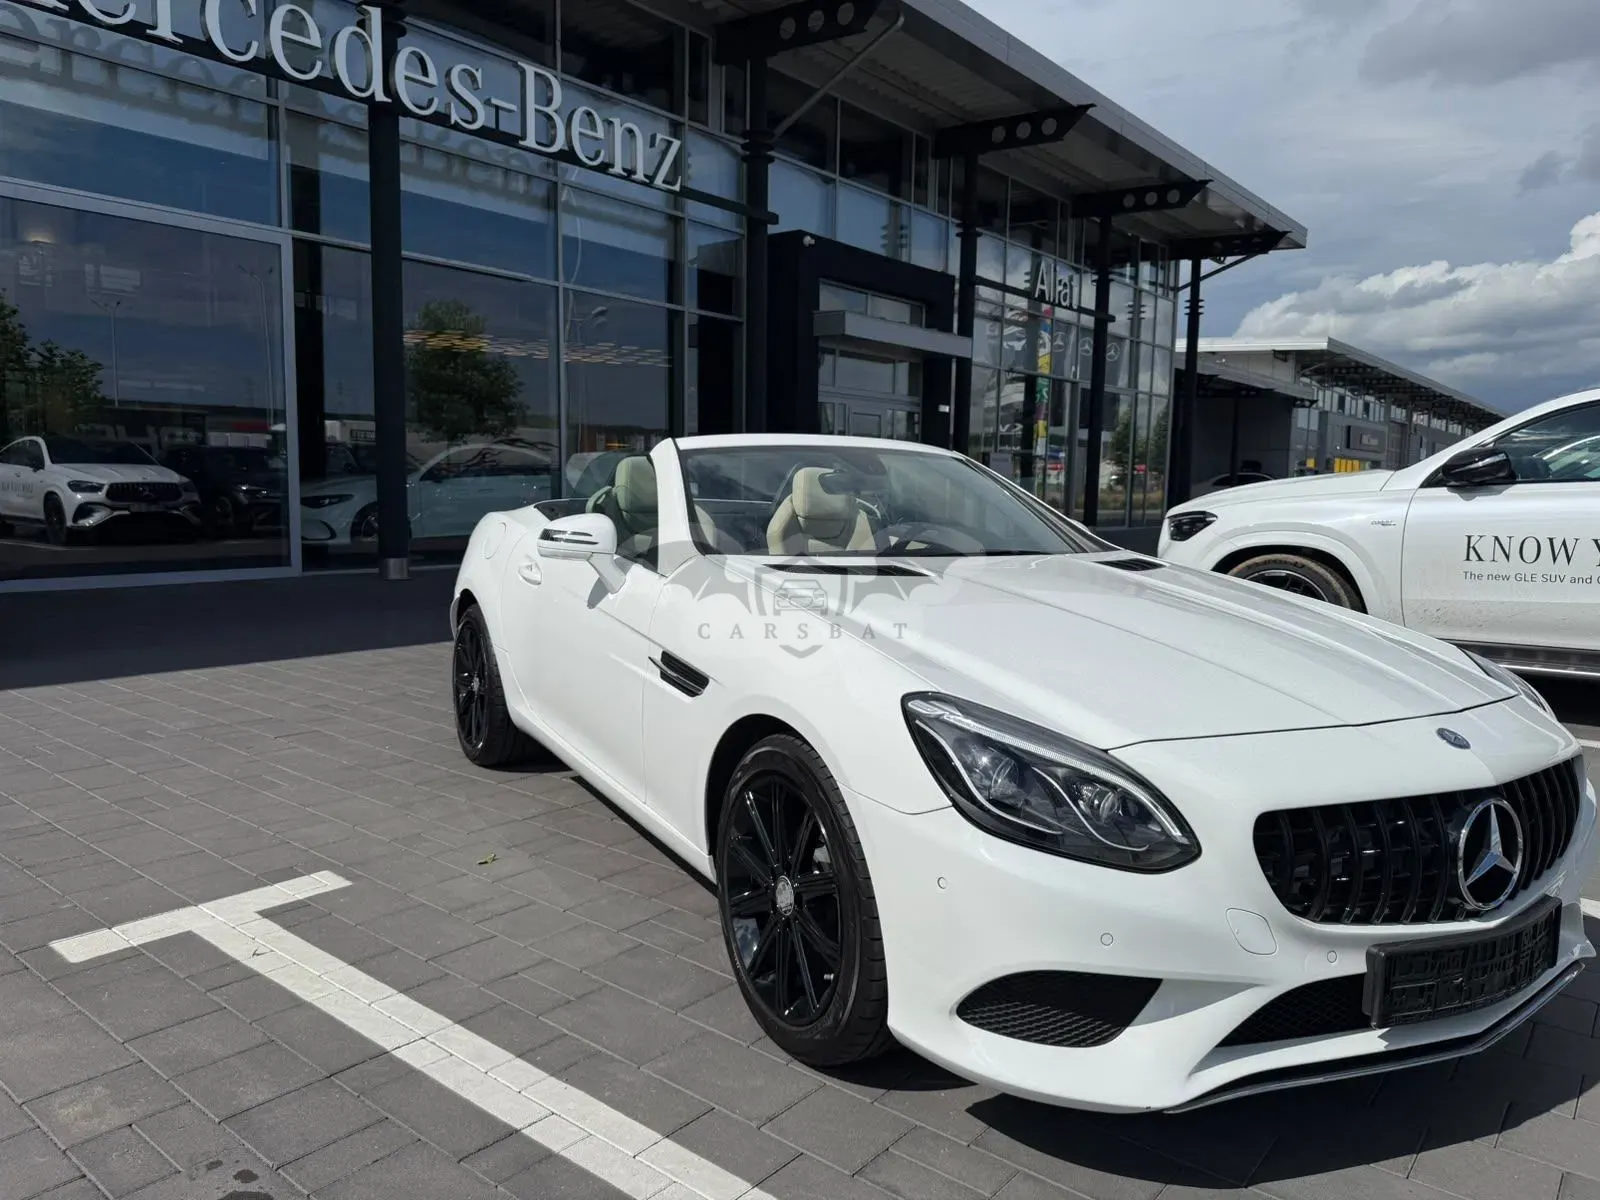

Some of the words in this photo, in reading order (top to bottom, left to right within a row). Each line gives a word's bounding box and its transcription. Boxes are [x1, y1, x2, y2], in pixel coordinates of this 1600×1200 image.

[26, 0, 682, 192] cedes-Benz
[1463, 534, 1581, 566] KNOW
[1463, 571, 1484, 581] The
[1487, 574, 1511, 582] new
[1514, 572, 1538, 583] GLE
[1541, 573, 1567, 583] SUV
[1570, 574, 1593, 585] and
